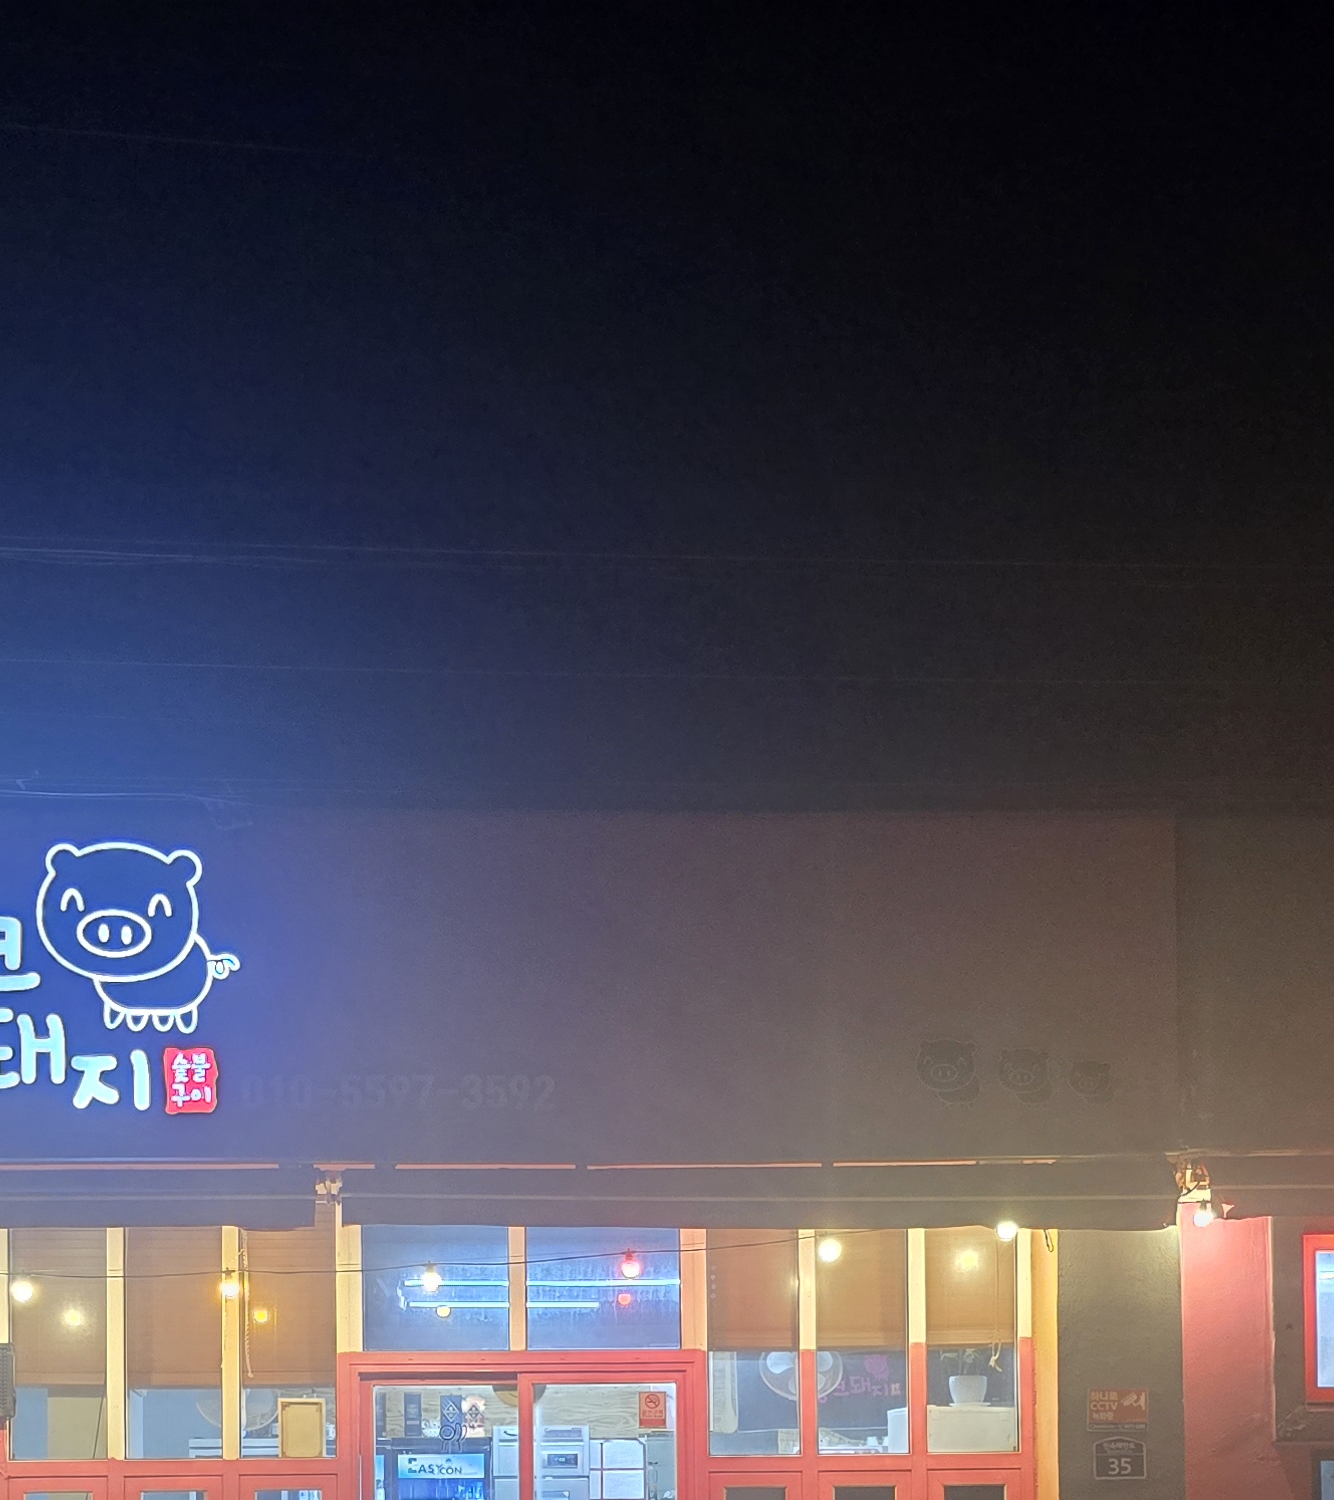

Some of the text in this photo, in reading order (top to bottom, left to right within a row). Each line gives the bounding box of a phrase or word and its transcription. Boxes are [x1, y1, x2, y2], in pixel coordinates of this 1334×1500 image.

[171, 1052, 211, 1083] 숯불
[171, 1083, 212, 1108] 구이
[241, 1073, 555, 1112] 010-5597-3592
[1090, 1401, 1118, 1411] CCTV
[1108, 1457, 1132, 1475] 35
